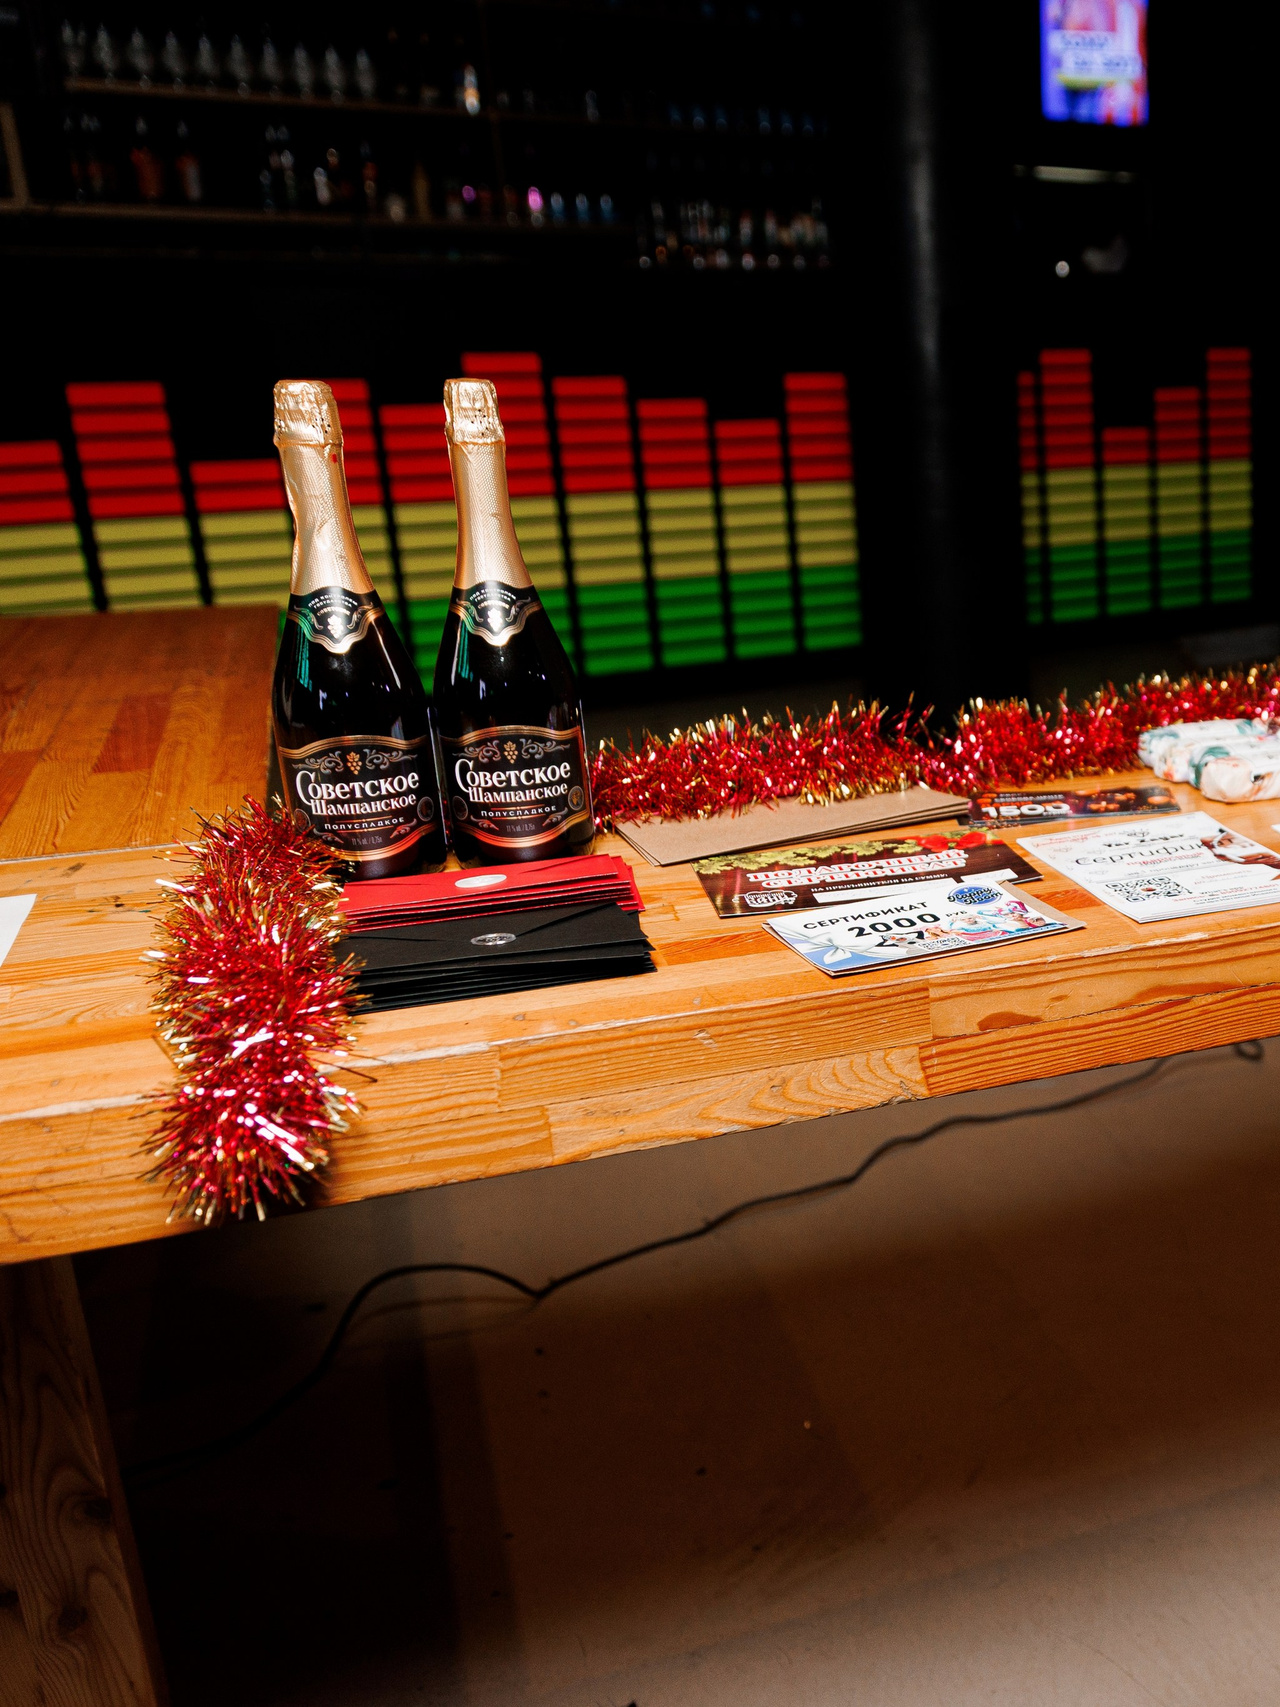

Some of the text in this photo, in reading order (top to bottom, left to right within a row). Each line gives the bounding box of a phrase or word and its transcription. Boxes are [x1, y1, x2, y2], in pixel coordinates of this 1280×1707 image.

[296, 770, 419, 805] Советское
[455, 759, 571, 793] Советское
[311, 793, 417, 816] Шампанское
[468, 782, 568, 803] Шампанское
[981, 803, 1070, 818] 1500
[1076, 838, 1233, 865] Сертификт
[803, 901, 928, 930] СЕРТИФИКАТ
[847, 913, 940, 938] 2000
